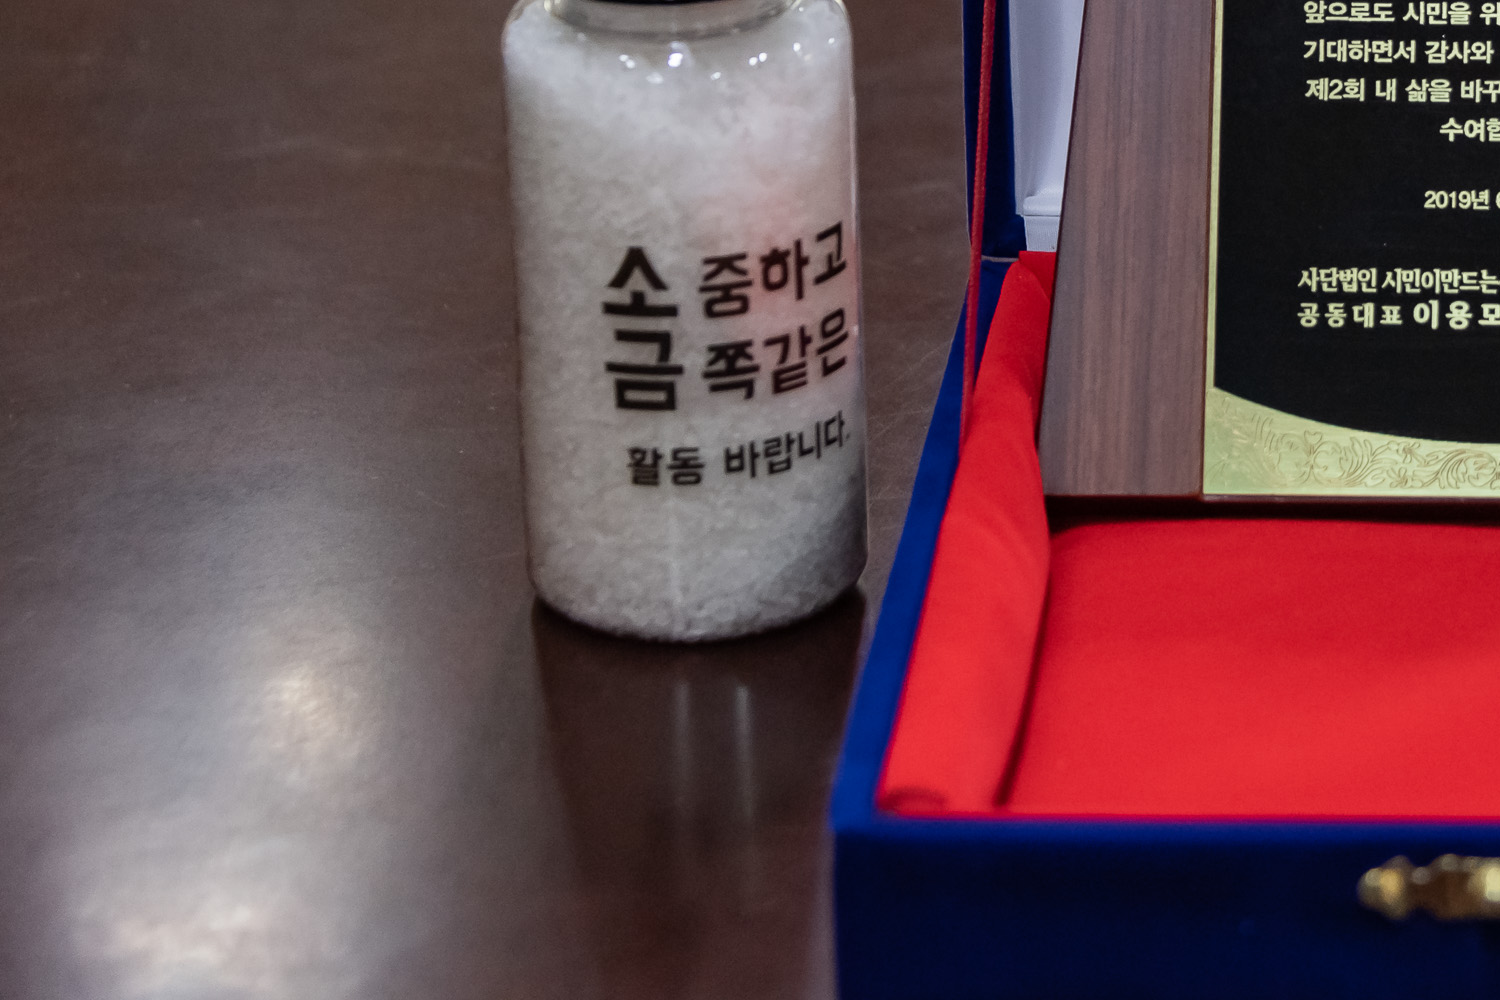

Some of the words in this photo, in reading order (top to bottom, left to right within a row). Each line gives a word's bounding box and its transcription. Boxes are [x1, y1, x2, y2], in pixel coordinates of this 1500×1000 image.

[1303, 0, 1396, 24] 앞으로도
[1403, 1, 1472, 25] 시민을
[1303, 39, 1417, 64] 기대하면서
[1424, 40, 1495, 65] 감사와
[1305, 78, 1365, 102] 제2회
[1375, 78, 1397, 103] 내
[1405, 79, 1453, 103] 삶을
[1423, 189, 1490, 211] 2019년
[1297, 267, 1377, 293] 사단법인
[626, 446, 706, 487] 활동
[724, 410, 852, 479] 바랍니다.
